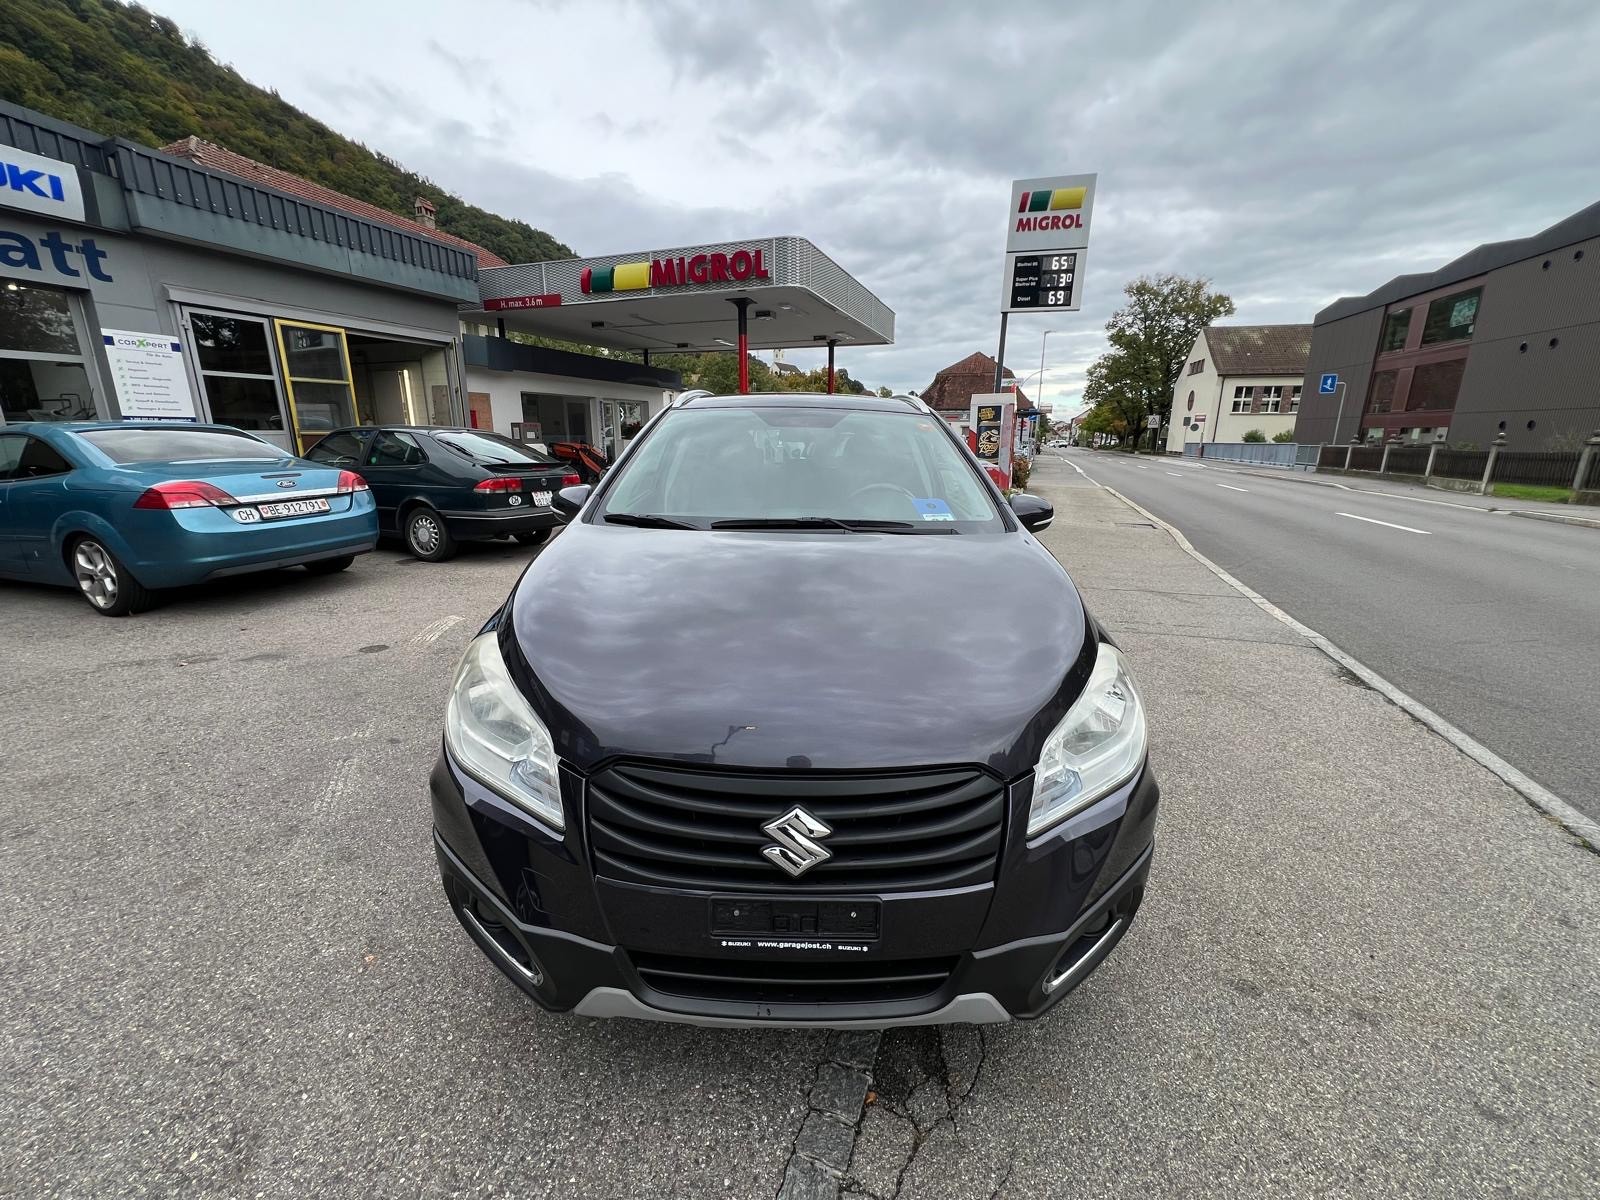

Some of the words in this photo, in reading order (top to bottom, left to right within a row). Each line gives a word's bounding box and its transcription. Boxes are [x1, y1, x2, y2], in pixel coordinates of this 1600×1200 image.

[0, 162, 64, 202] KI
[1016, 214, 1082, 232] MIGROL
[651, 249, 768, 288] MIGROL
[238, 508, 255, 521] CH
[757, 941, 832, 950] www.garagejost.ch
